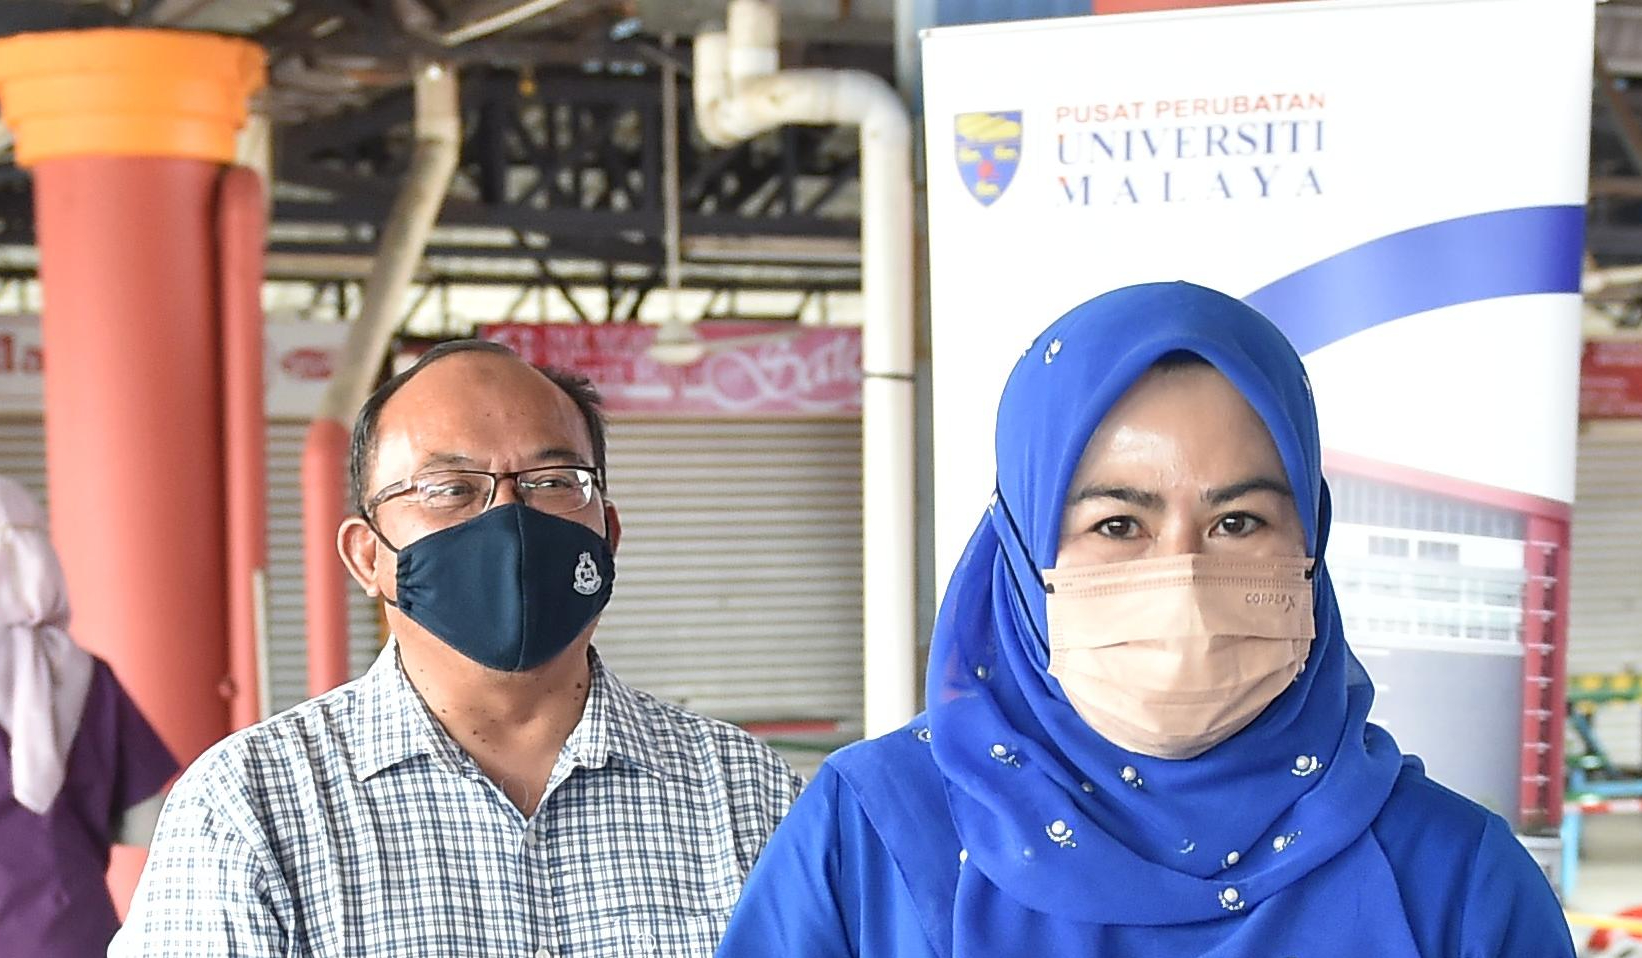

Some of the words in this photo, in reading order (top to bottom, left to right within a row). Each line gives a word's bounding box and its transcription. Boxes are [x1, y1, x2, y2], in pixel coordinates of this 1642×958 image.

[1056, 102, 1144, 123] PUSAT
[1156, 93, 1325, 118] PERUBATAN
[1058, 120, 1324, 166] UNIVERSITI
[1057, 164, 1324, 206] MALAYA
